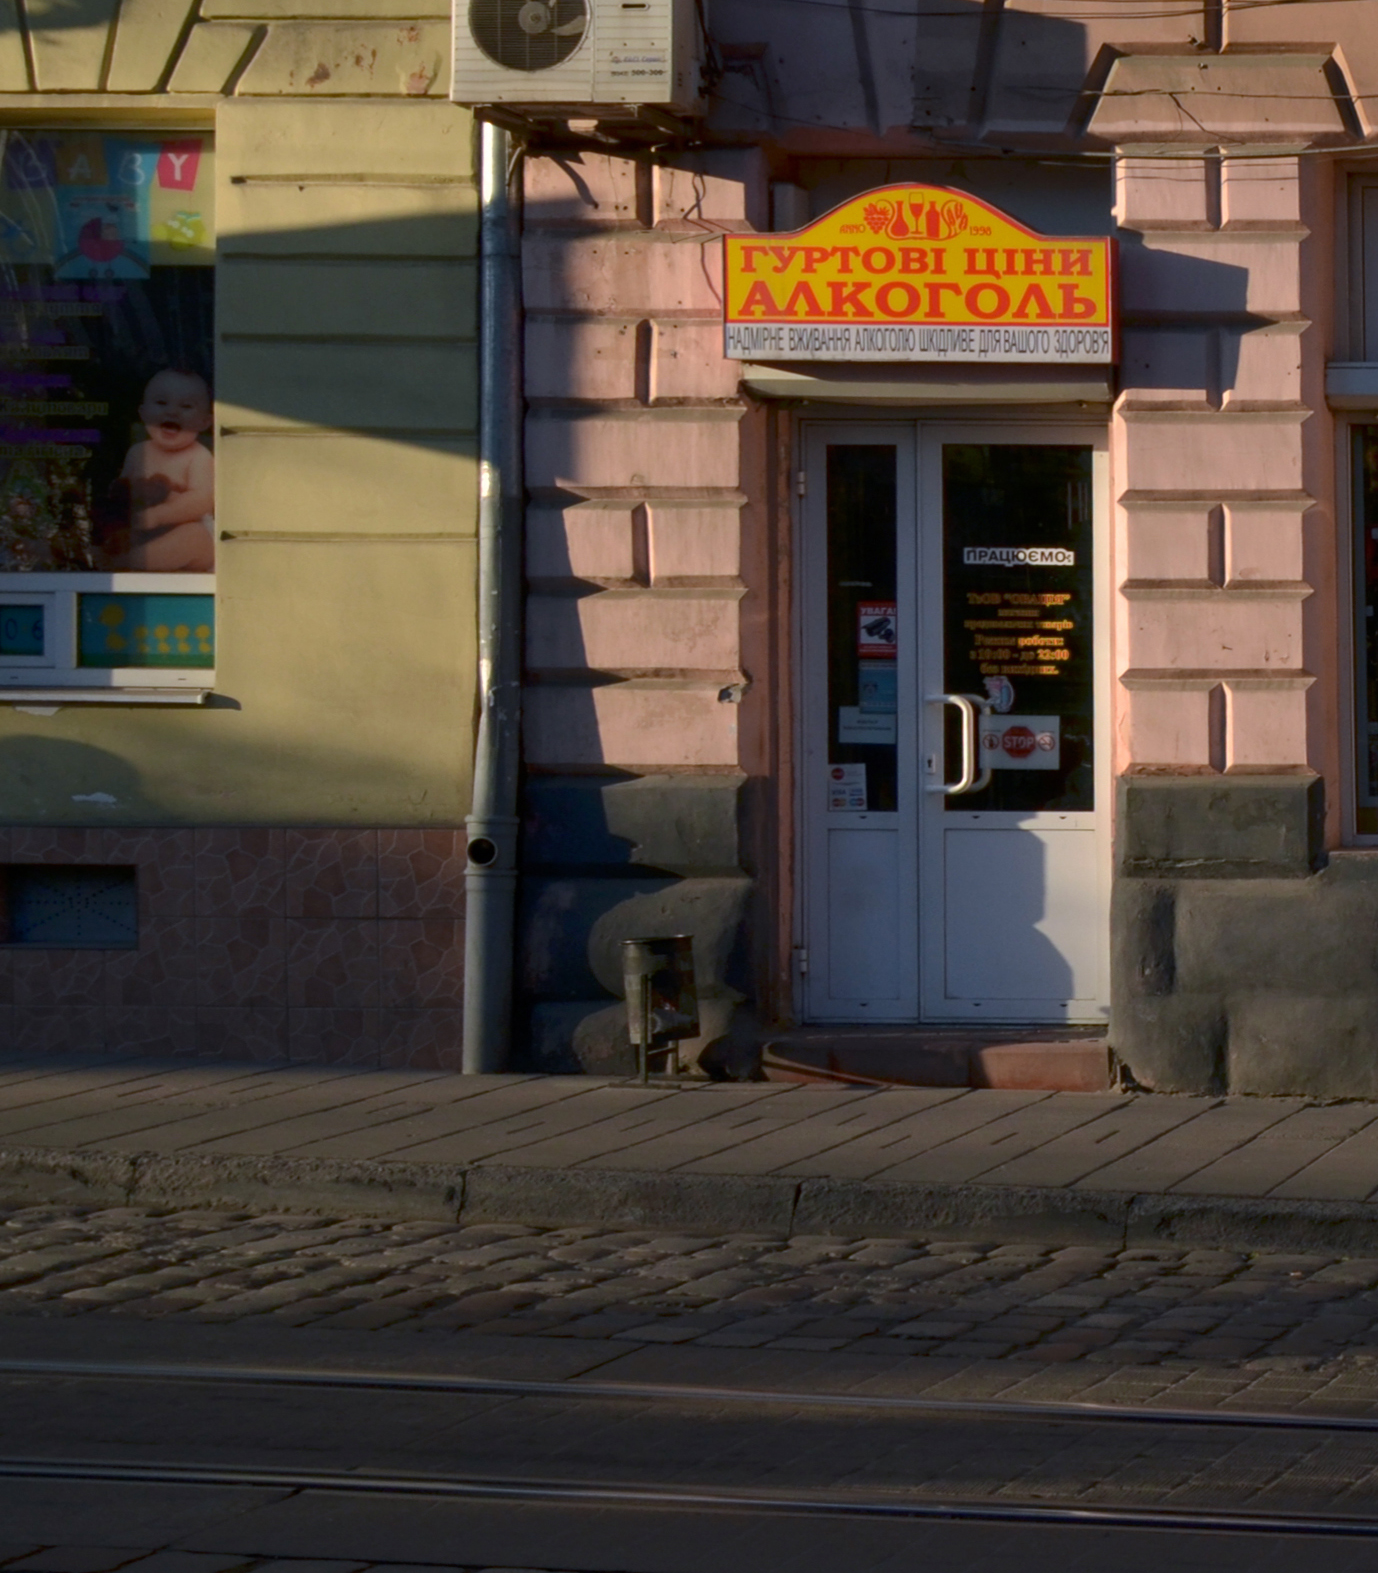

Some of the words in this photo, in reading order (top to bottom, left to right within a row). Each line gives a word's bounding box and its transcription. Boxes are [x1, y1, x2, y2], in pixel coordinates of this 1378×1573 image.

[840, 224, 866, 234] ANNO
[969, 226, 992, 236] 1998
[740, 245, 947, 276] ГУРТОВІ
[963, 248, 1093, 280] ЦІНИ
[738, 280, 1098, 320] АЛКОГОЛЬ
[727, 327, 784, 355] НАДМІРНЕ
[788, 328, 850, 352] ВЖИВАННЯ
[854, 328, 916, 352] АЛКОГОЛЮ
[919, 328, 975, 357] ШКІДЛИВЕ
[978, 329, 1000, 358] ДЛЯ
[1003, 329, 1050, 353] ВАШОГО
[1003, 735, 1035, 750] STOP
